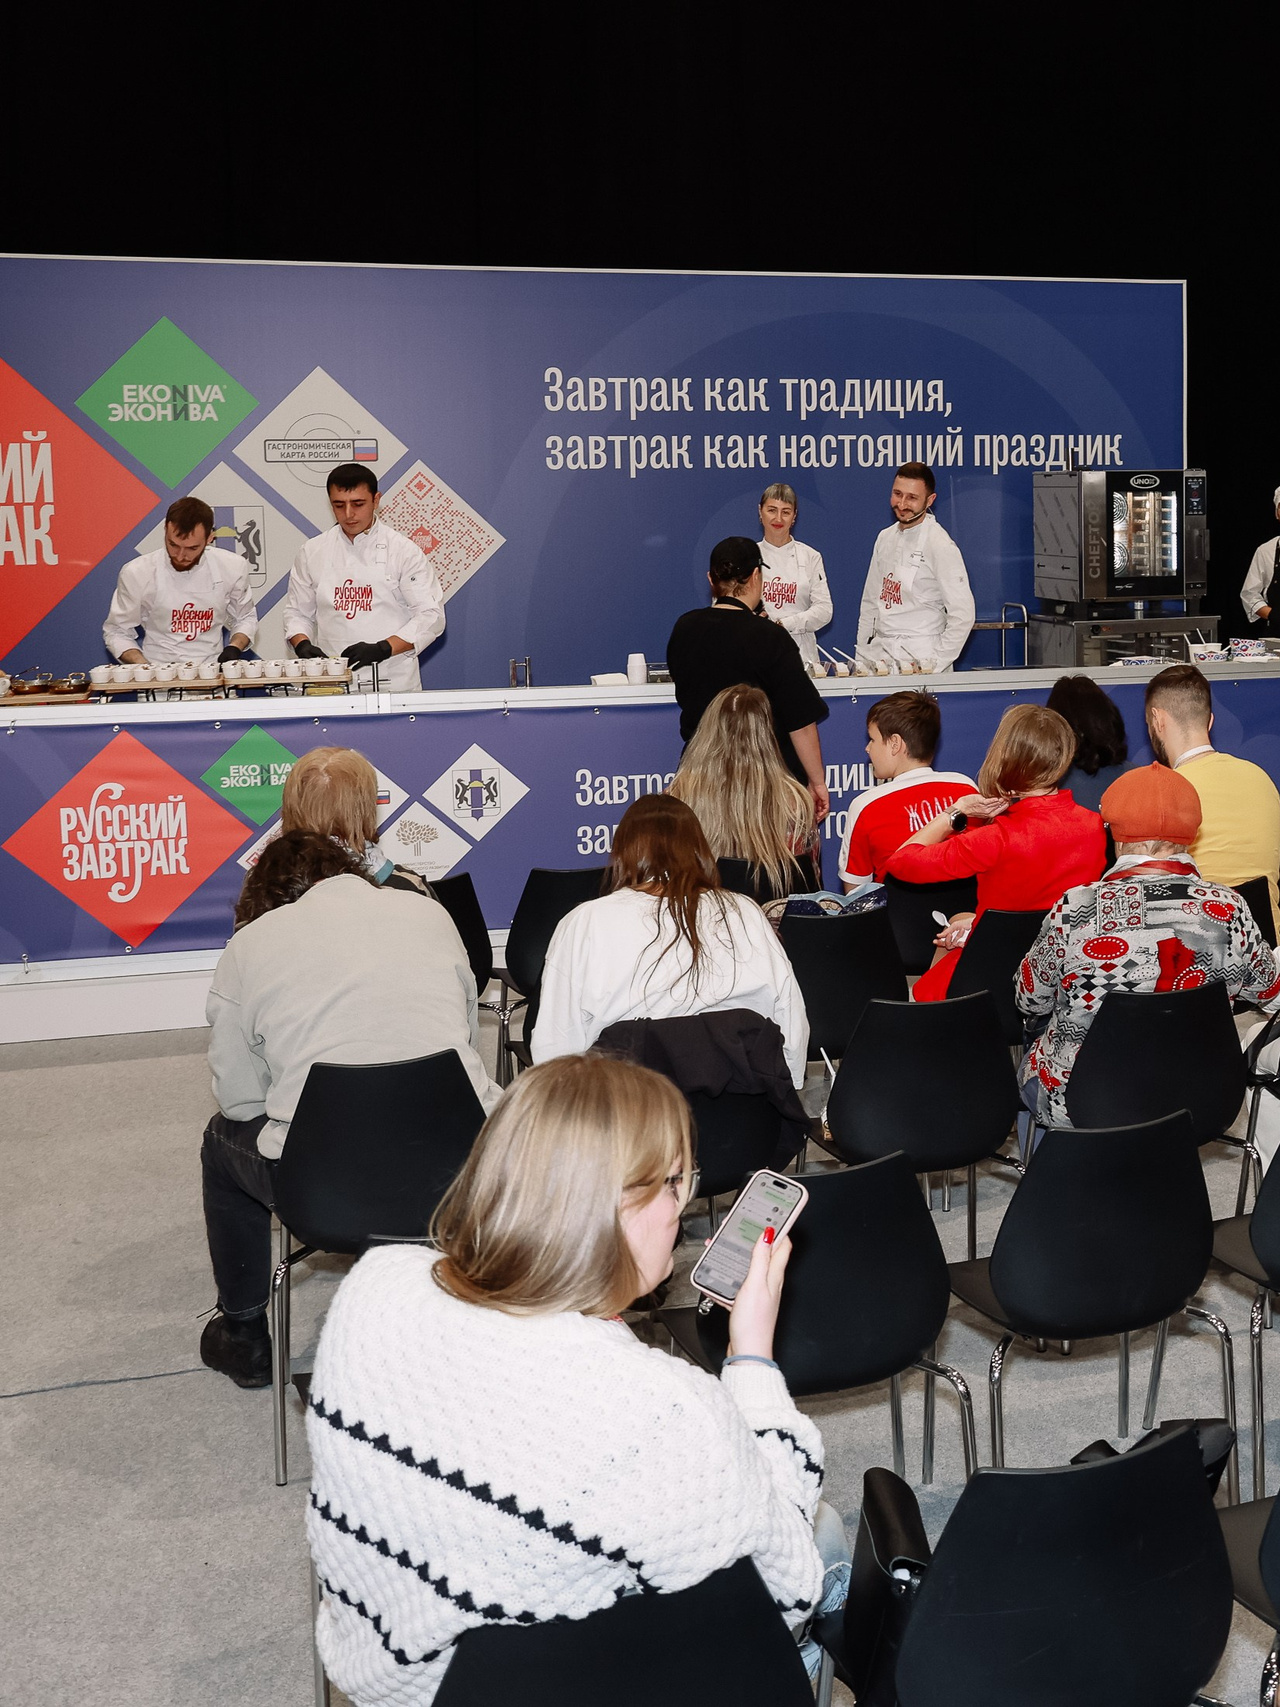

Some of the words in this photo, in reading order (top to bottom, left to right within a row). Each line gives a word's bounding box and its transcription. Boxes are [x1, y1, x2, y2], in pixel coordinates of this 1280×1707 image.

[122, 384, 226, 403] EKONIVA
[543, 366, 694, 421] Завтрак
[704, 377, 770, 412] как
[779, 378, 952, 421] традиция,
[107, 403, 219, 421] ЭКОНИВА
[267, 442, 352, 451] ГАСТРОНОМИЧЕСКАЯ
[280, 451, 306, 459] КАРТА
[308, 451, 340, 459] РОССИИ
[545, 434, 694, 479] завтрак
[704, 434, 770, 469] как
[779, 426, 964, 468] настоящий
[974, 433, 1123, 475] праздник
[333, 578, 373, 600] РУССКИЙ
[171, 602, 214, 621] РУССКИЙ
[333, 599, 373, 620] ЗАВТРАК
[229, 762, 293, 776] EKONIVA
[59, 782, 188, 844] РУССКИЙ
[62, 837, 191, 903] ЗАВТРАК
